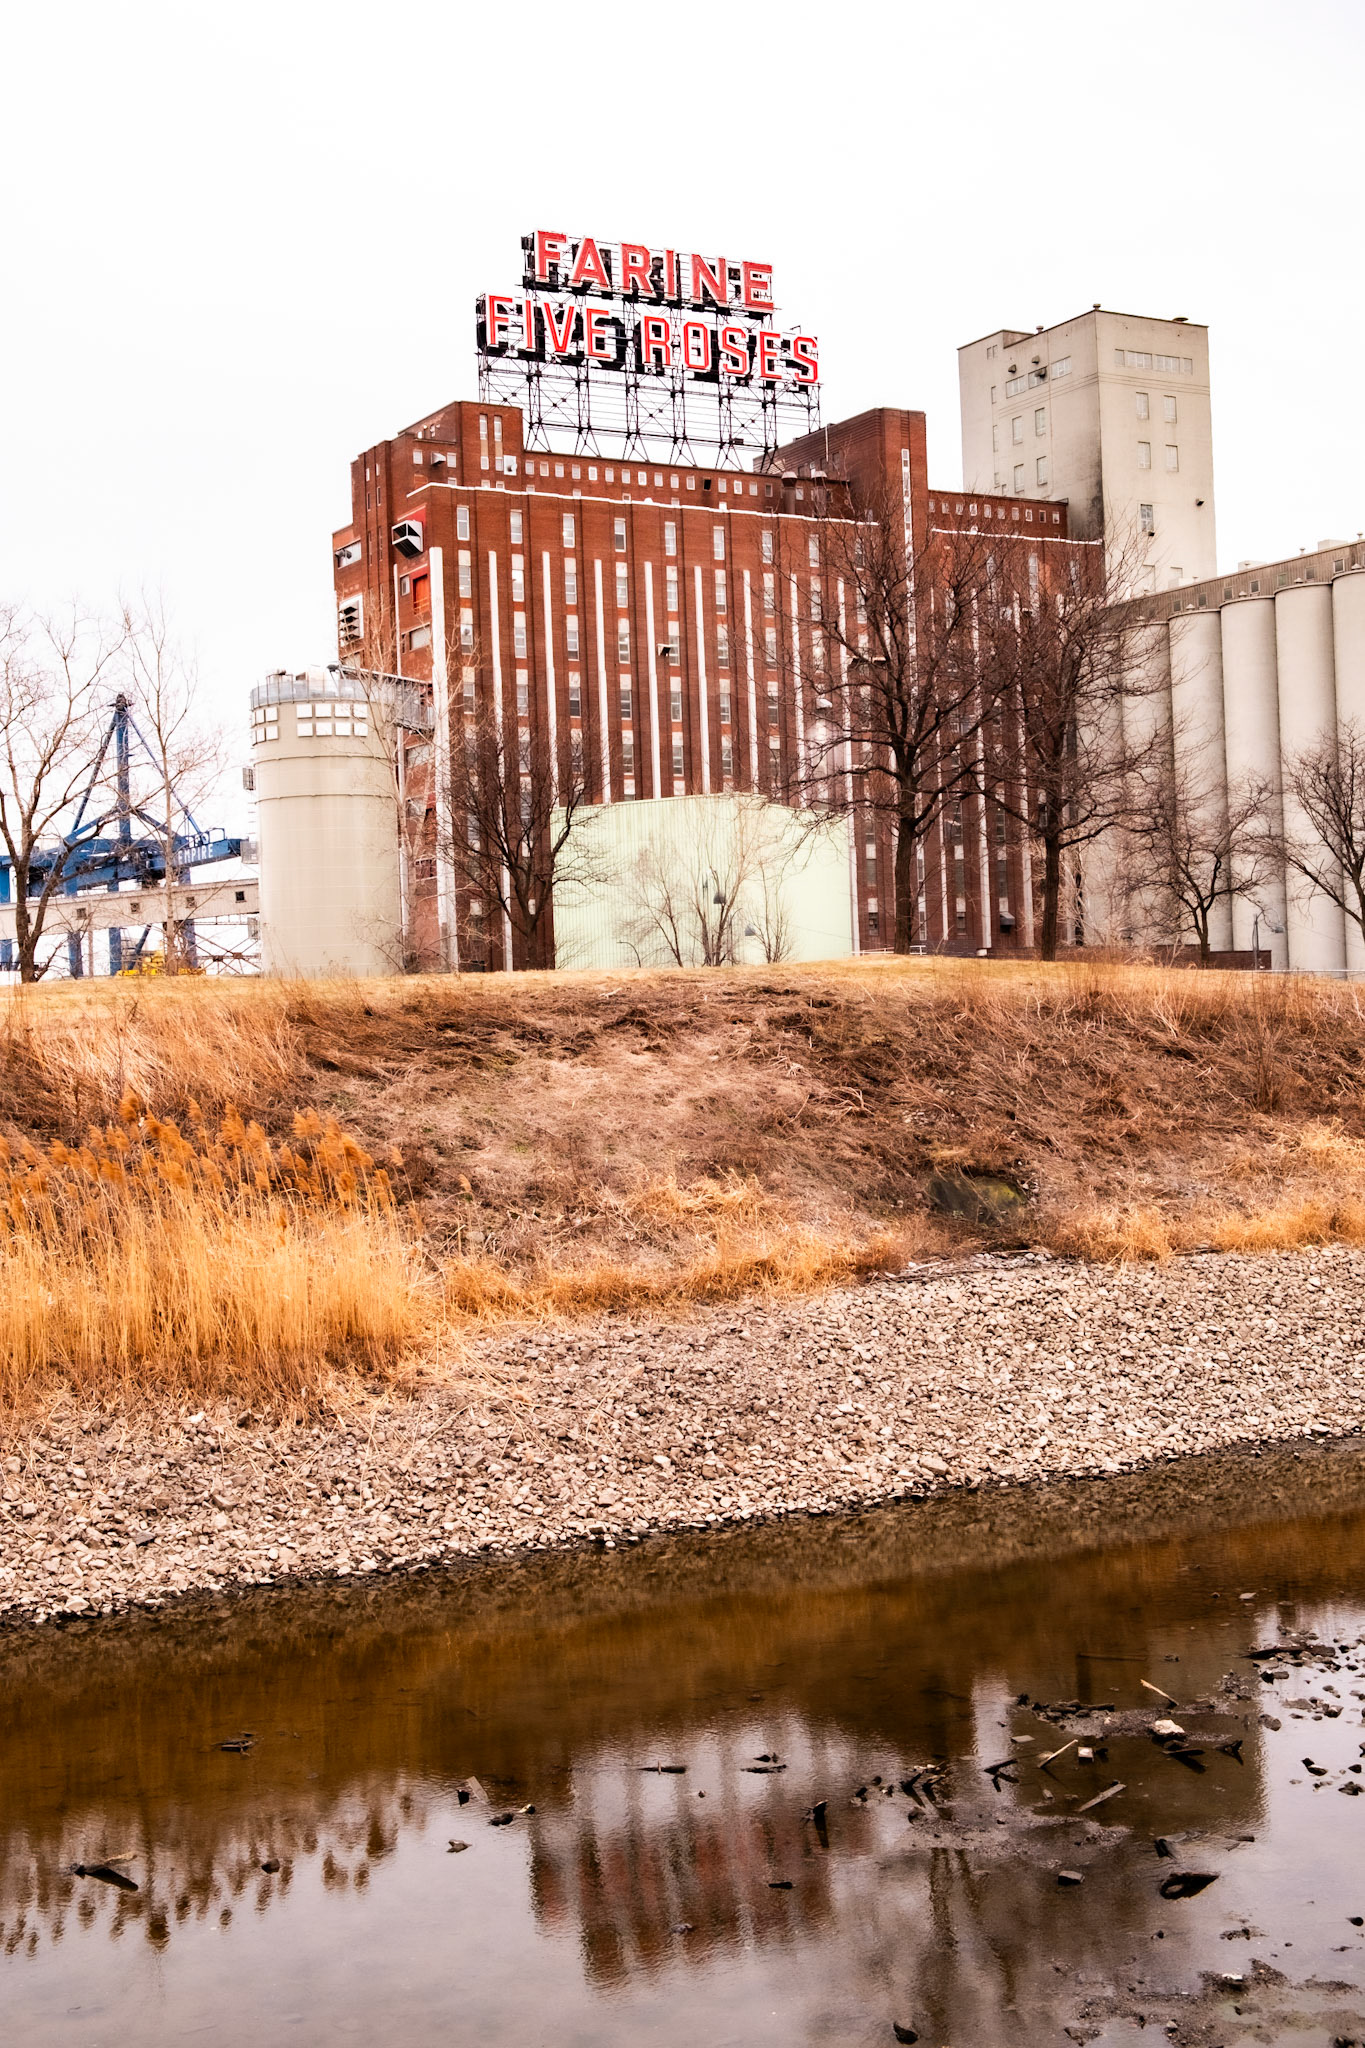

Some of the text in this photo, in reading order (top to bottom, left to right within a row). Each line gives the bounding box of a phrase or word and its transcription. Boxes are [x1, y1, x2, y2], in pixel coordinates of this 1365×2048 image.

[535, 229, 775, 311] FARINE
[486, 294, 819, 384] FIVE ROSES
[178, 843, 214, 866] EMPIRE
